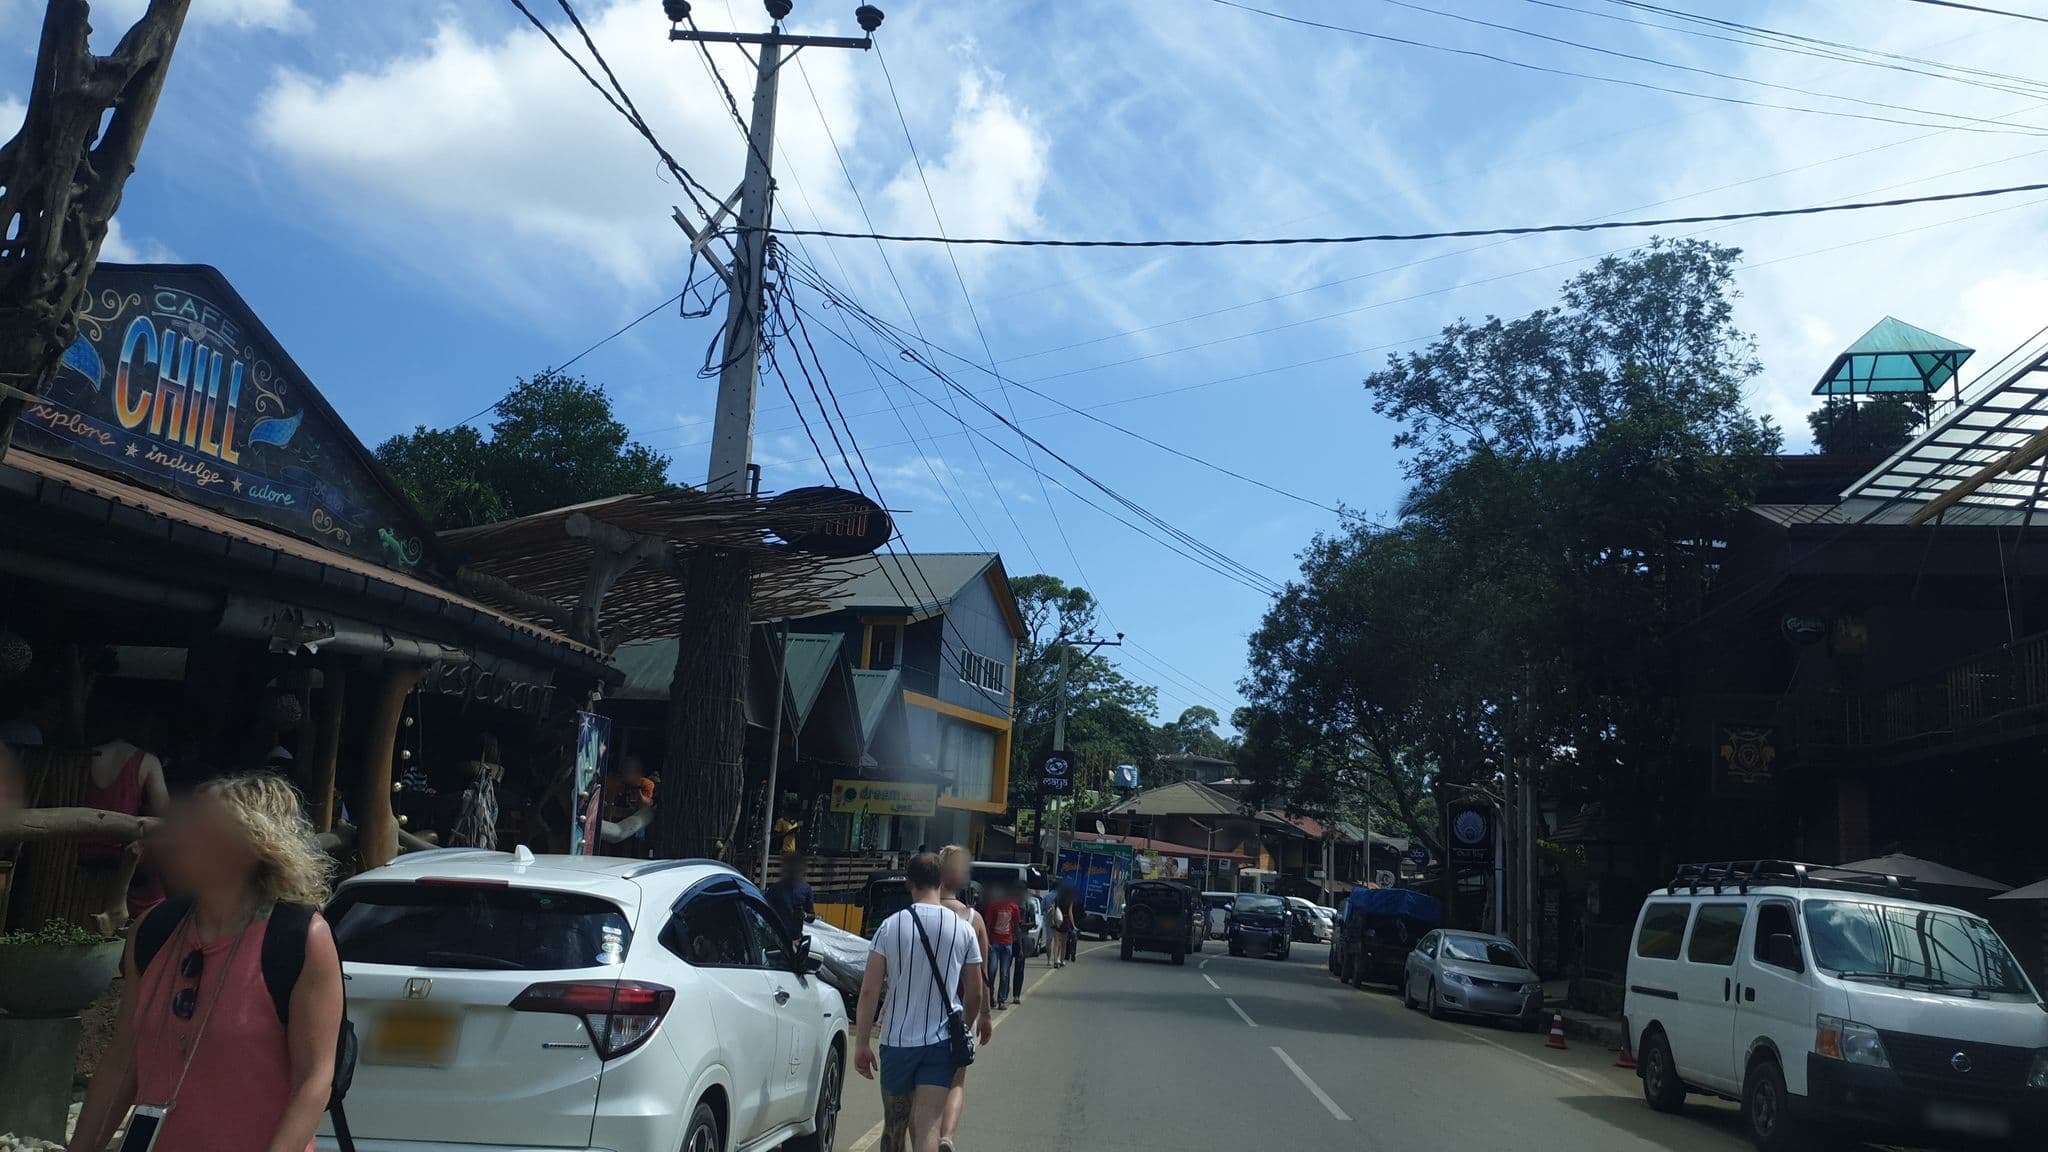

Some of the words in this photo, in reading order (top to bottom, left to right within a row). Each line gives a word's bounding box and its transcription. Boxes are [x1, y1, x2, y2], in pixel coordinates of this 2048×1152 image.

[154, 291, 240, 346] CAFE
[114, 314, 245, 465] CHILL
[27, 405, 116, 445] xplore
[145, 445, 224, 486] indulge
[249, 484, 295, 505] adore
